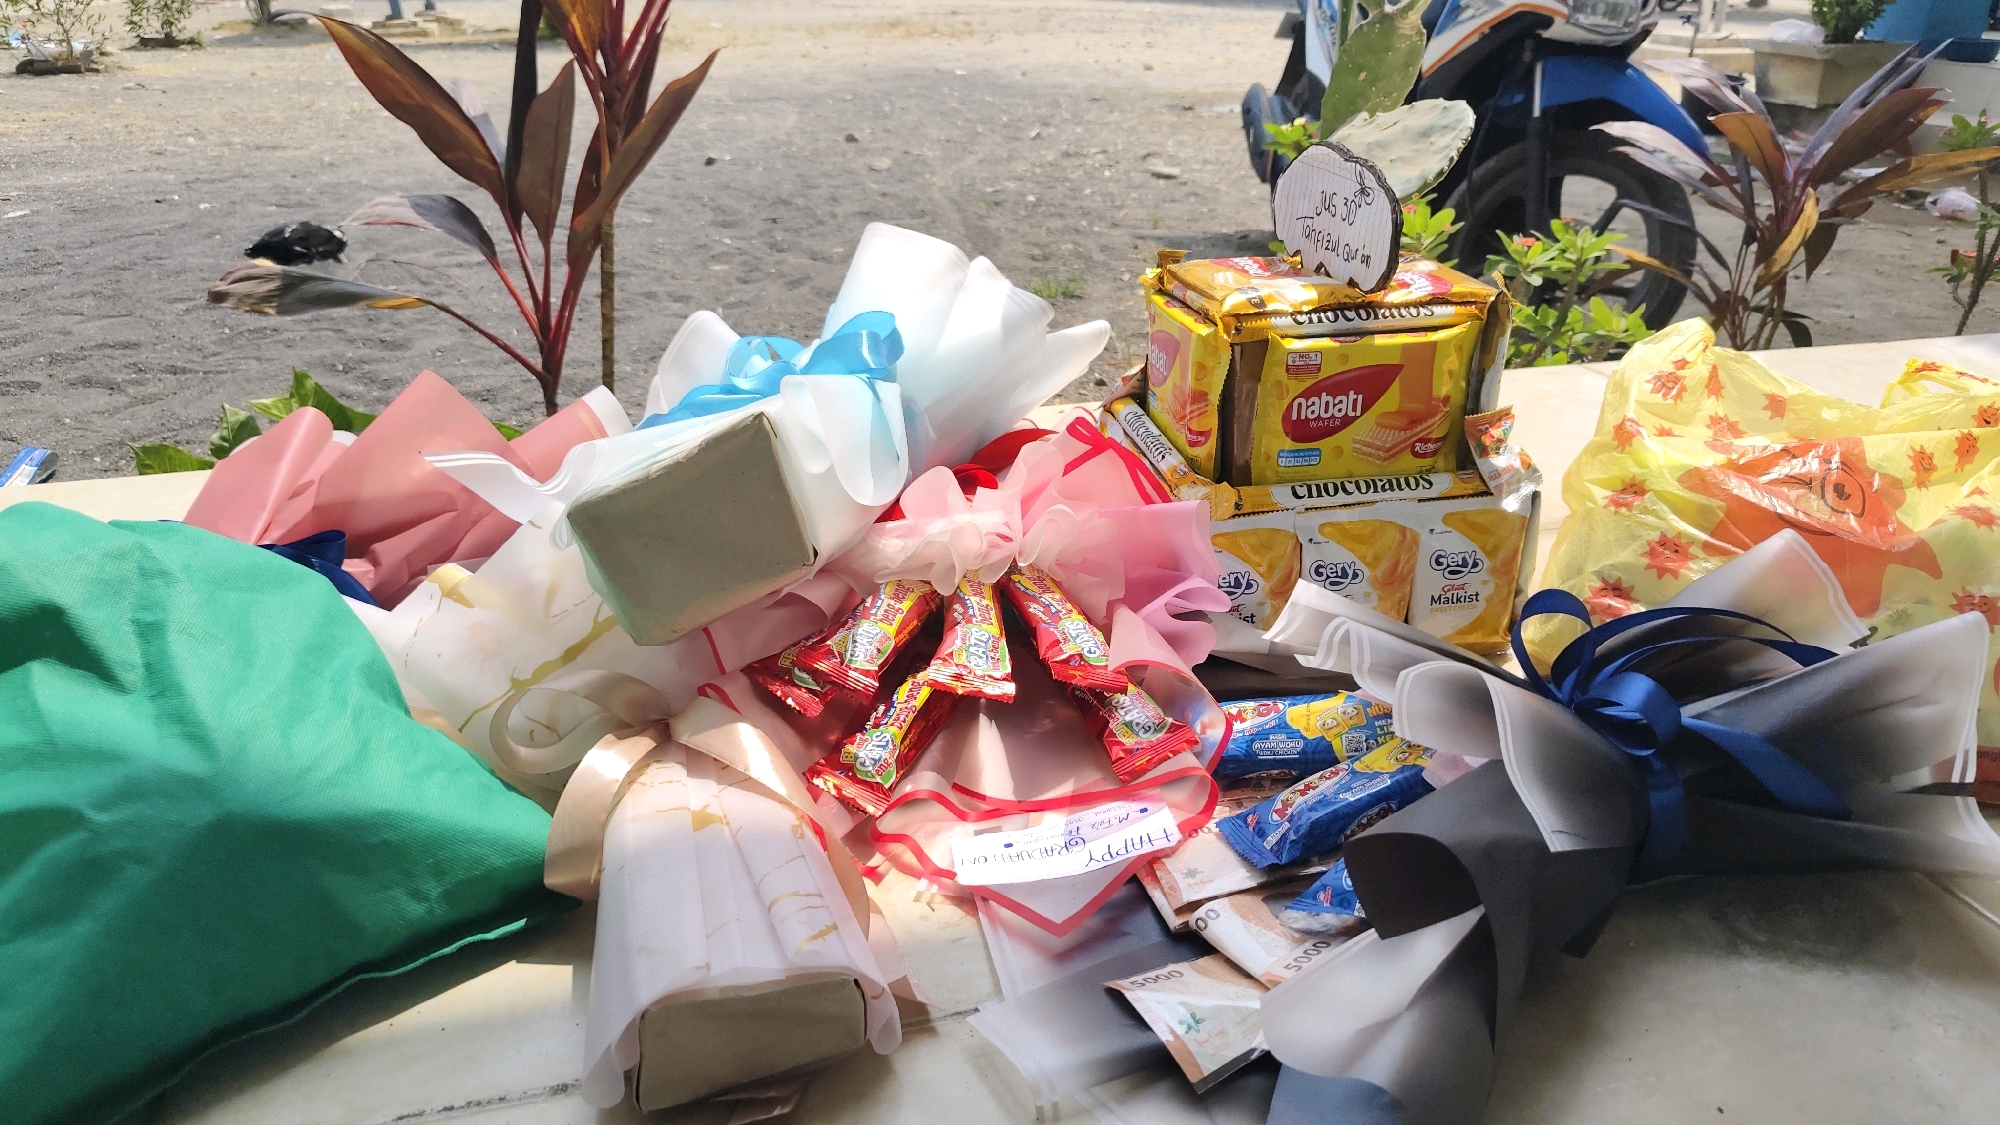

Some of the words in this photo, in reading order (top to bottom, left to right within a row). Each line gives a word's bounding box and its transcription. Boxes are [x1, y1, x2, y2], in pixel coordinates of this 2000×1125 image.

[1316, 190, 1337, 218] JUS
[1341, 197, 1358, 226] 30
[1292, 389, 1363, 421] nabati
[1124, 410, 1172, 463] chocolatos
[1309, 418, 1341, 428] WAFER
[1290, 473, 1434, 500] chocolatos
[1309, 559, 1364, 591] Gery
[1429, 549, 1484, 580] Gery
[1217, 571, 1259, 601] ery
[1430, 591, 1480, 606] Malkist
[876, 581, 915, 627] beng-beng
[969, 627, 991, 669] GRATIS
[1112, 695, 1155, 738] GRATIS
[1367, 704, 1393, 717] NUS
[1375, 719, 1393, 727] MEN
[1254, 741, 1277, 750] AYAM
[1278, 740, 1301, 750] WOKU
[1085, 827, 1174, 868] HAPPY
[1194, 908, 1222, 933] 00
[1284, 939, 1333, 973] 5000
[1129, 968, 1185, 989] 5000
